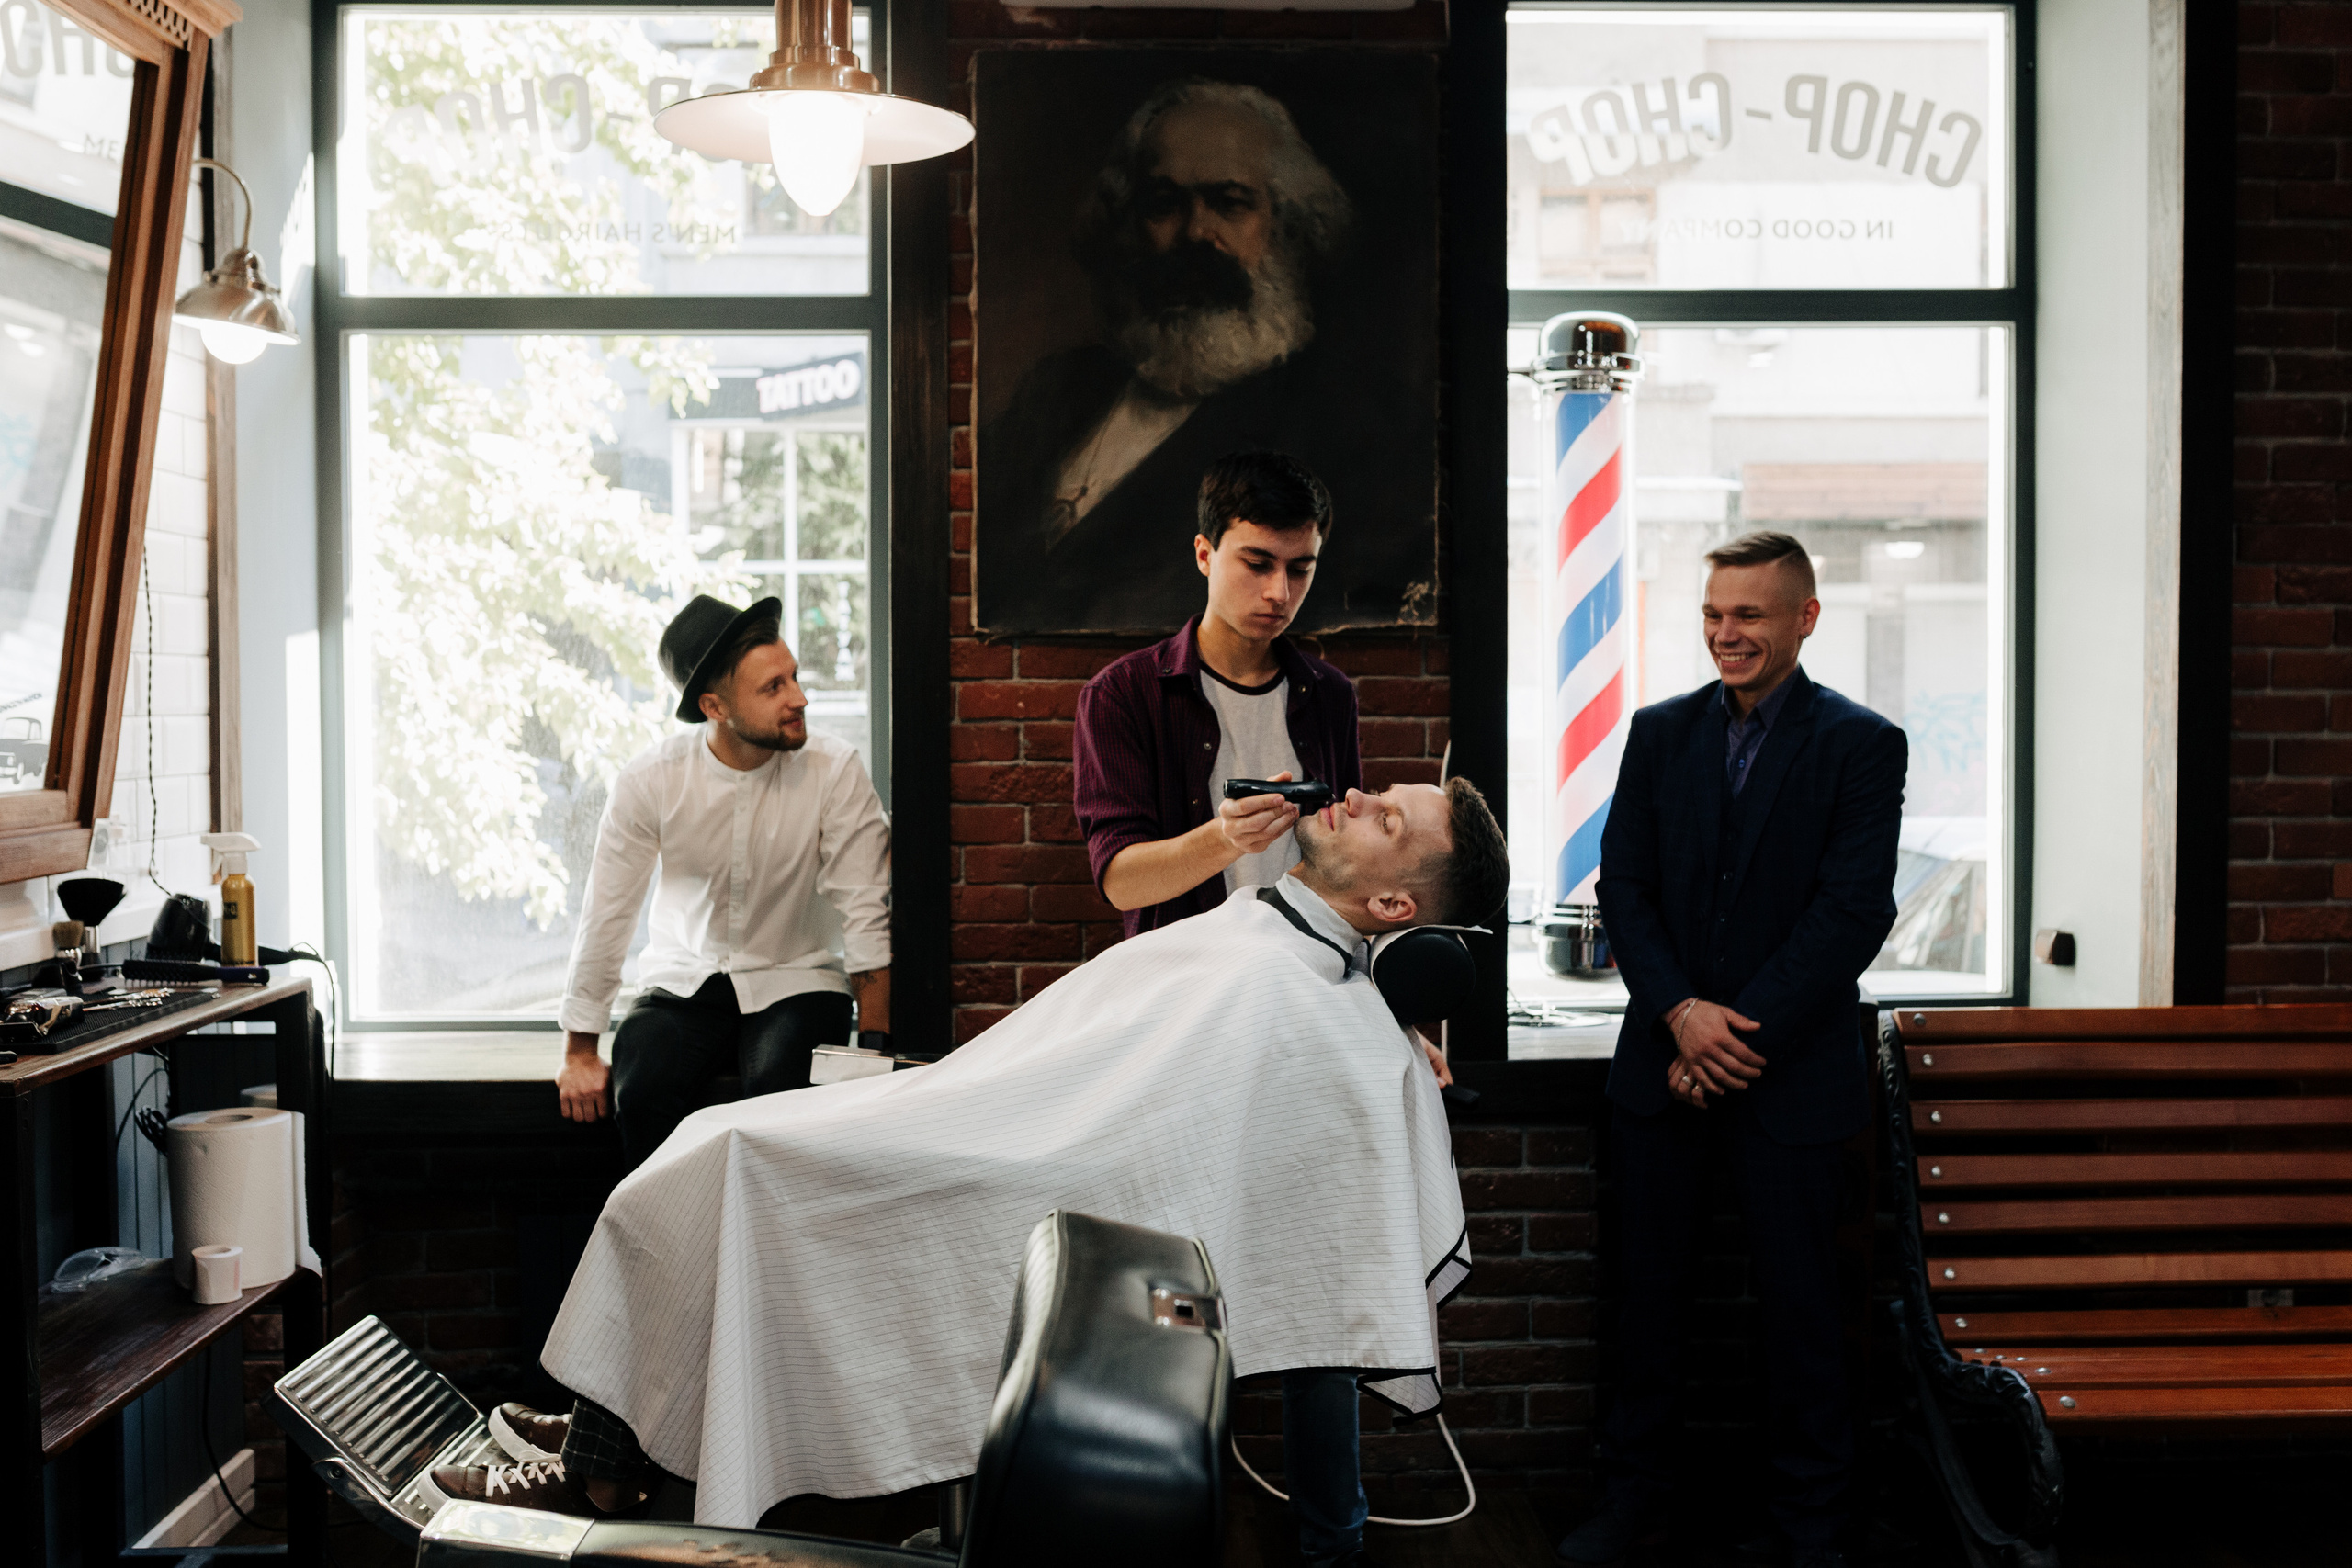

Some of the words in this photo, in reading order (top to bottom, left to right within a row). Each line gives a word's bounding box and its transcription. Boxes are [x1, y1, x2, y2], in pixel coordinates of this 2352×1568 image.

[0, 0, 134, 77] CH
[83, 133, 121, 162] ME
[756, 359, 862, 413] TATTOO
